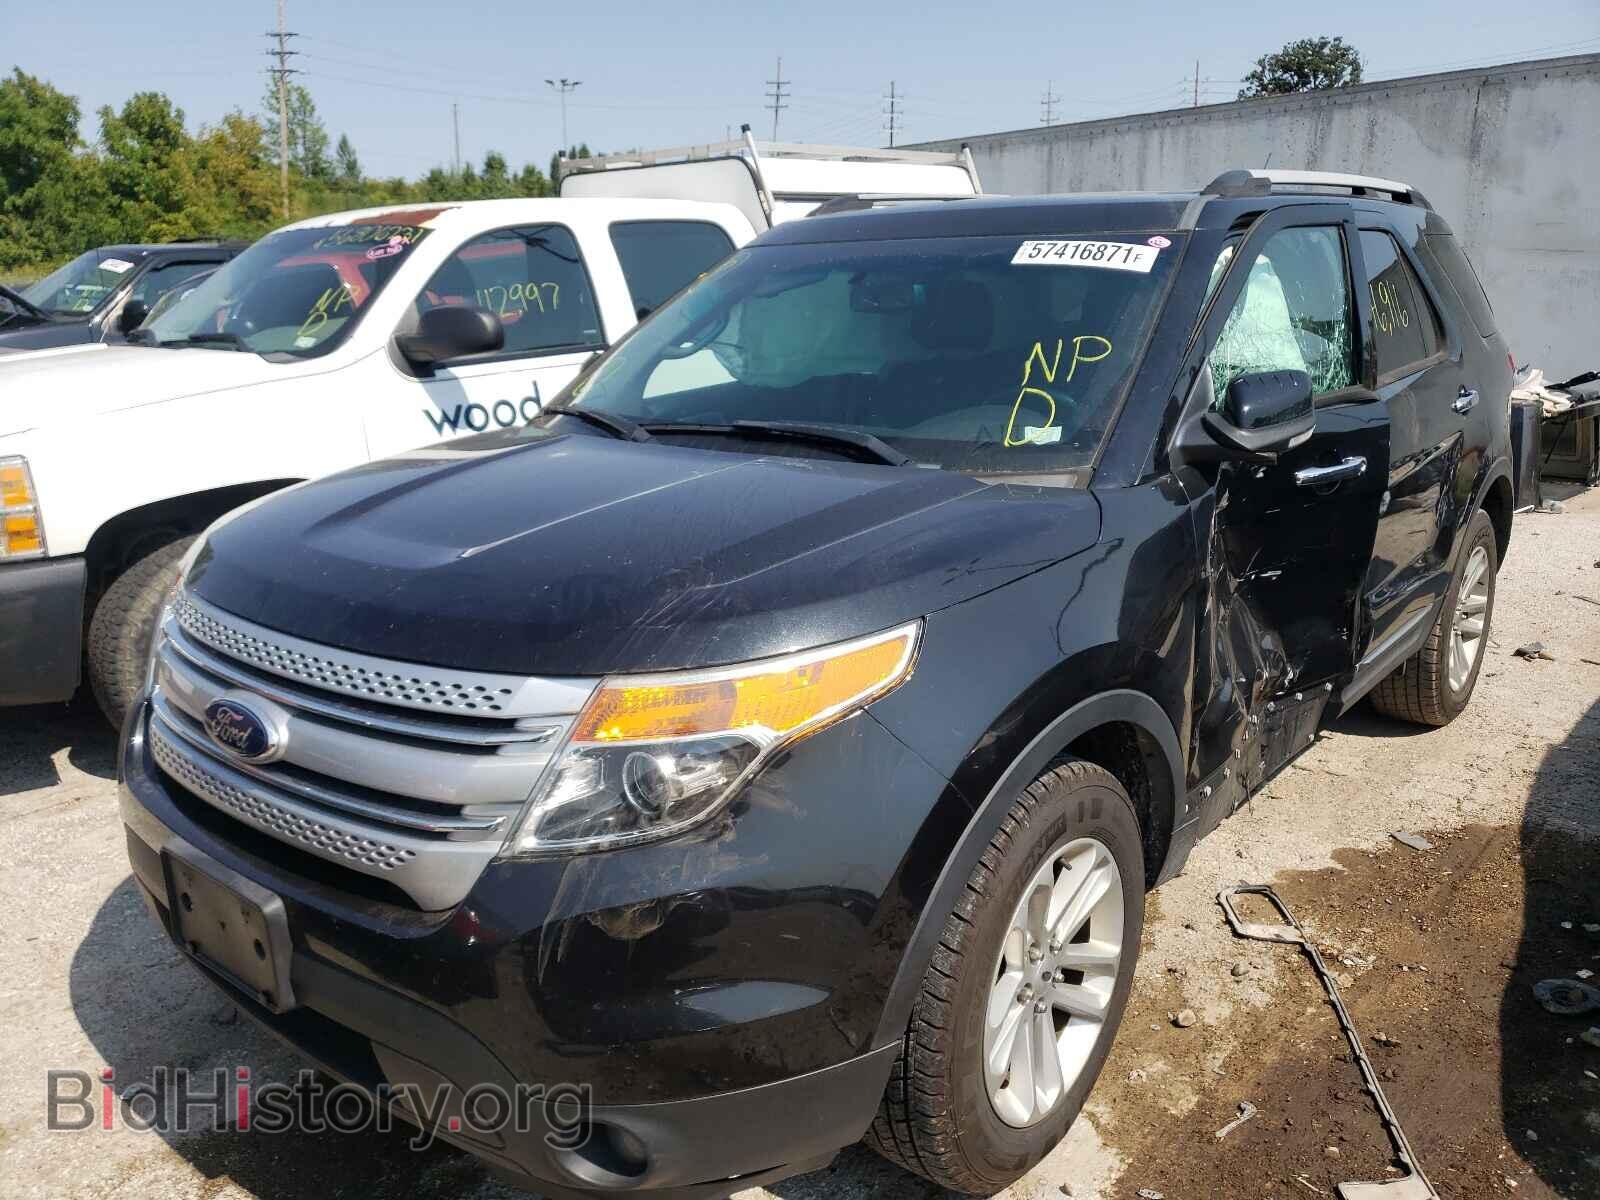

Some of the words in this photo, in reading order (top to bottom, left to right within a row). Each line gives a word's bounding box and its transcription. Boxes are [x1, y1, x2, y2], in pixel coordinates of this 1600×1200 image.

[1028, 242, 1134, 264] 57416871
[1021, 335, 1113, 387] NP
[422, 380, 543, 437] wood
[1003, 386, 1056, 448] D
[207, 706, 254, 750] Ford
